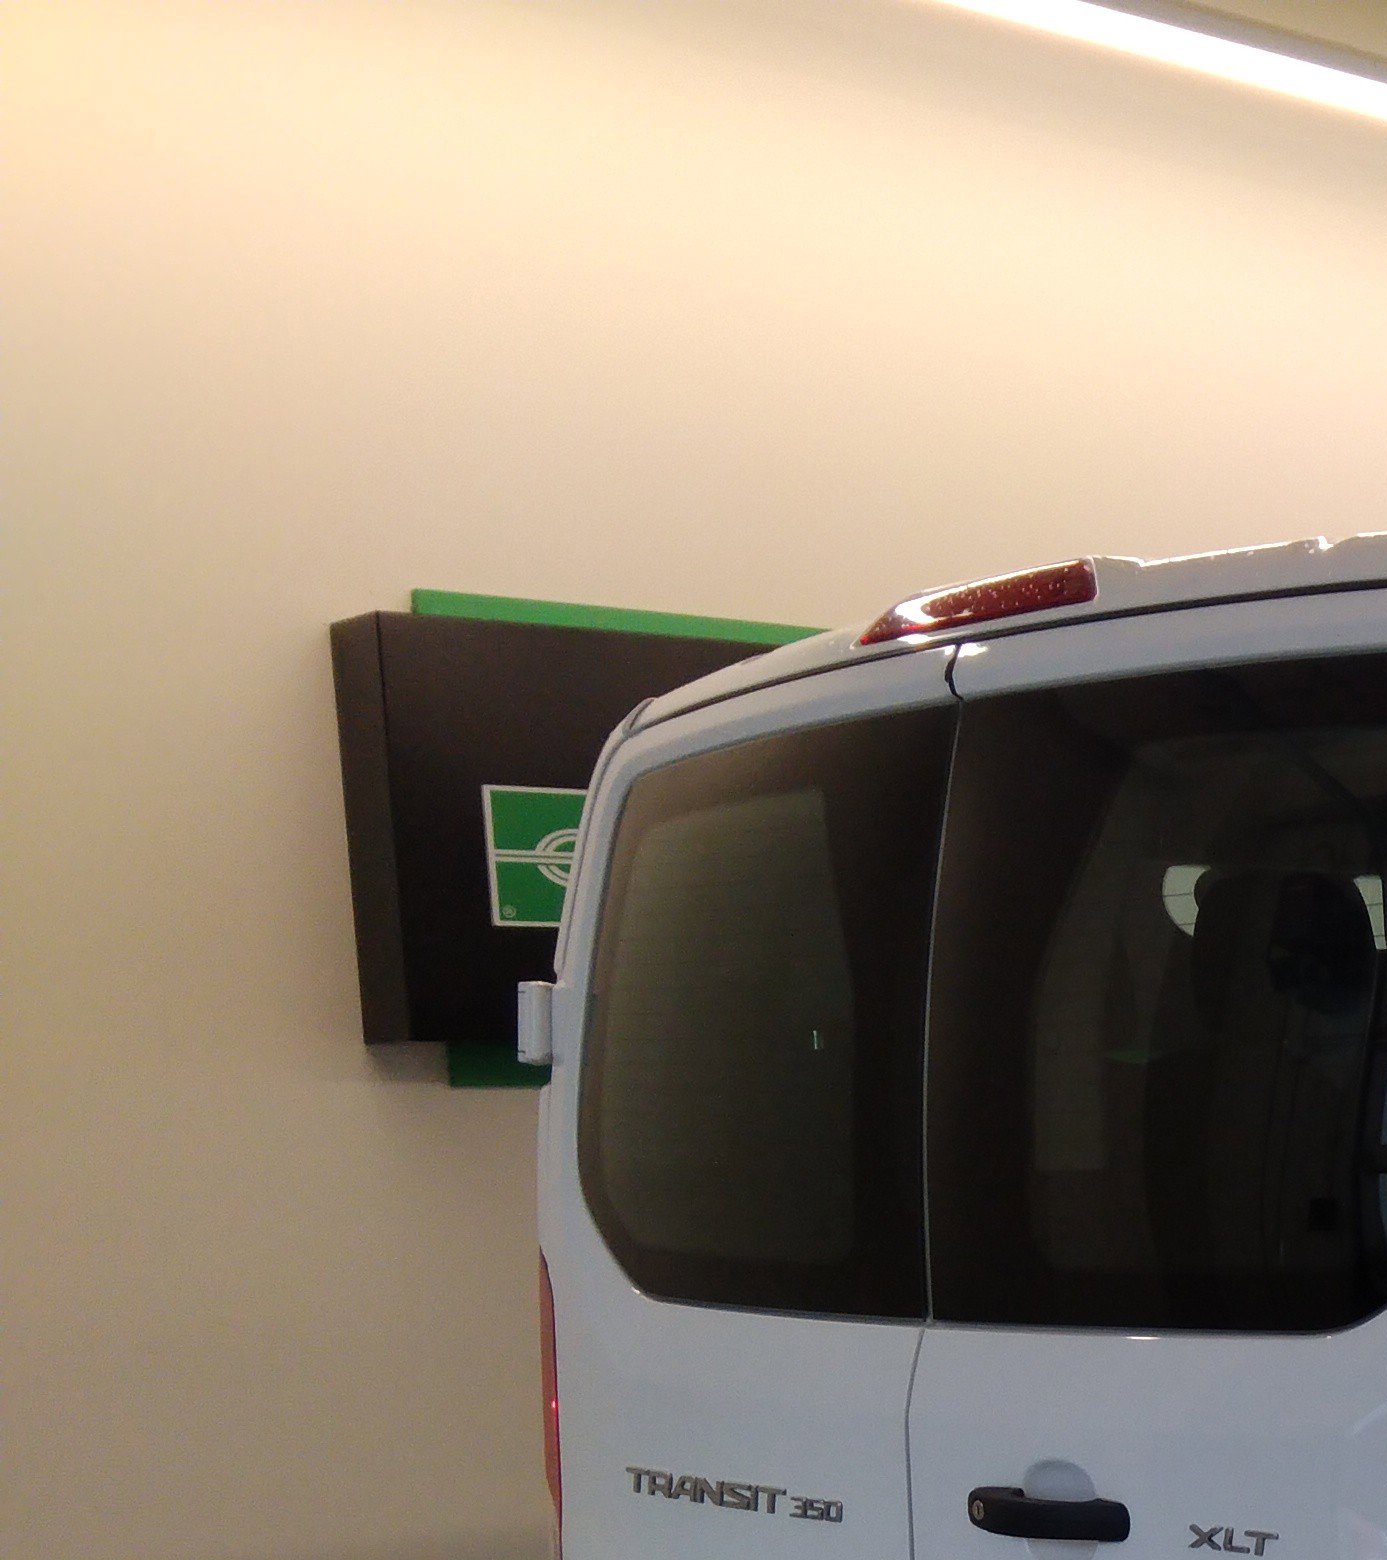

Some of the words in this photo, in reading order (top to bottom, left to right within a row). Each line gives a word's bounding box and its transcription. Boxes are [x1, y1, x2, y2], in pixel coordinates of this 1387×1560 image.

[626, 1466, 787, 1514] TRANSIT
[789, 1496, 843, 1523] 350
[1187, 1523, 1280, 1557] XLT
